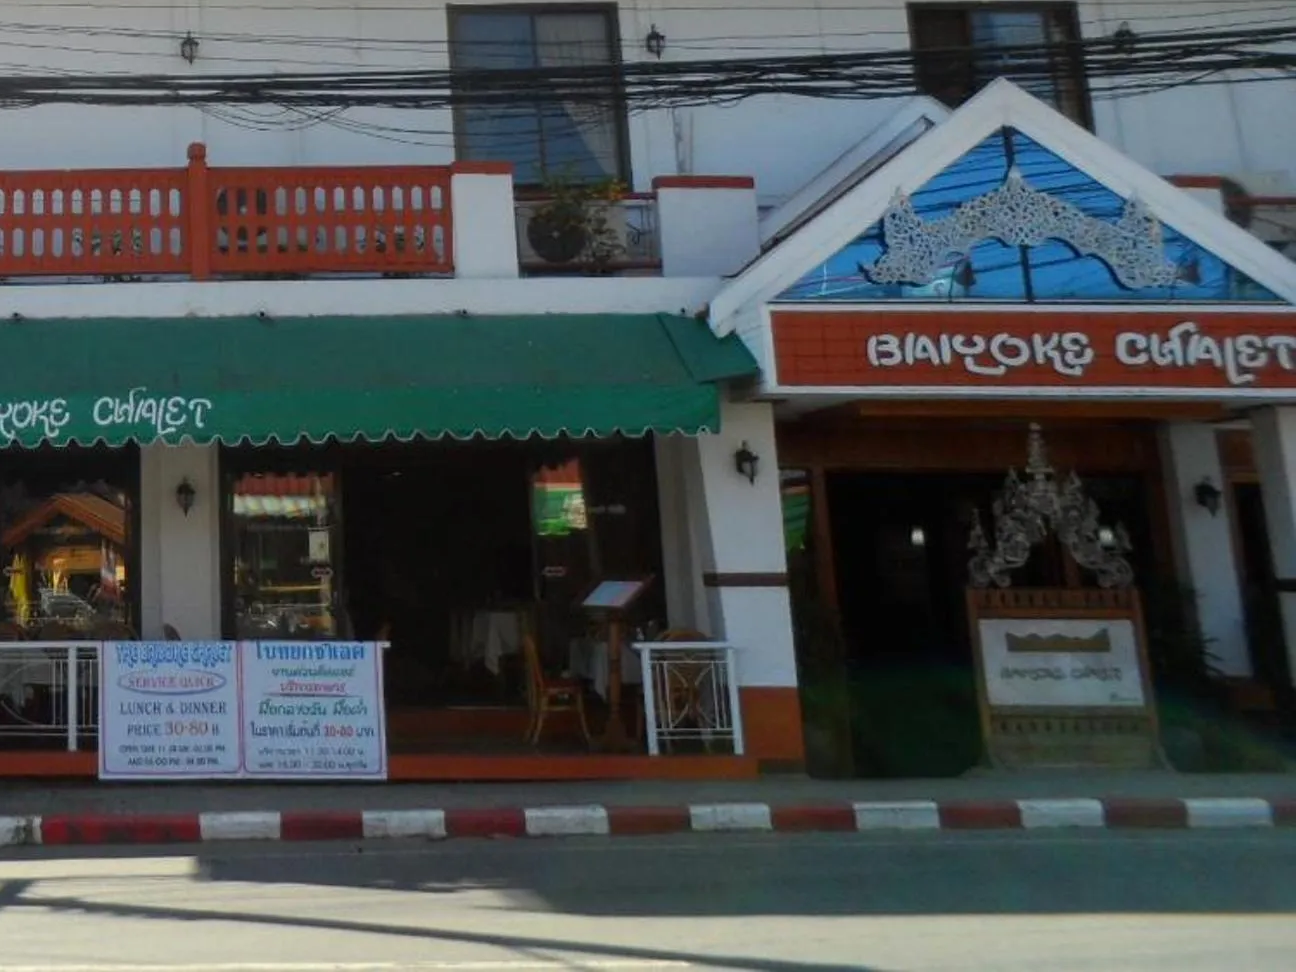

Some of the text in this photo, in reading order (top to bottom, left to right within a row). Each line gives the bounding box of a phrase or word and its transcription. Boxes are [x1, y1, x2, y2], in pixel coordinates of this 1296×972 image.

[866, 321, 1296, 384] BAIYOKE CHALET
[93, 387, 212, 435] CHALET
[119, 701, 162, 716] LUNCH
[179, 701, 227, 716] DINNER
[127, 723, 161, 737] PRICE
